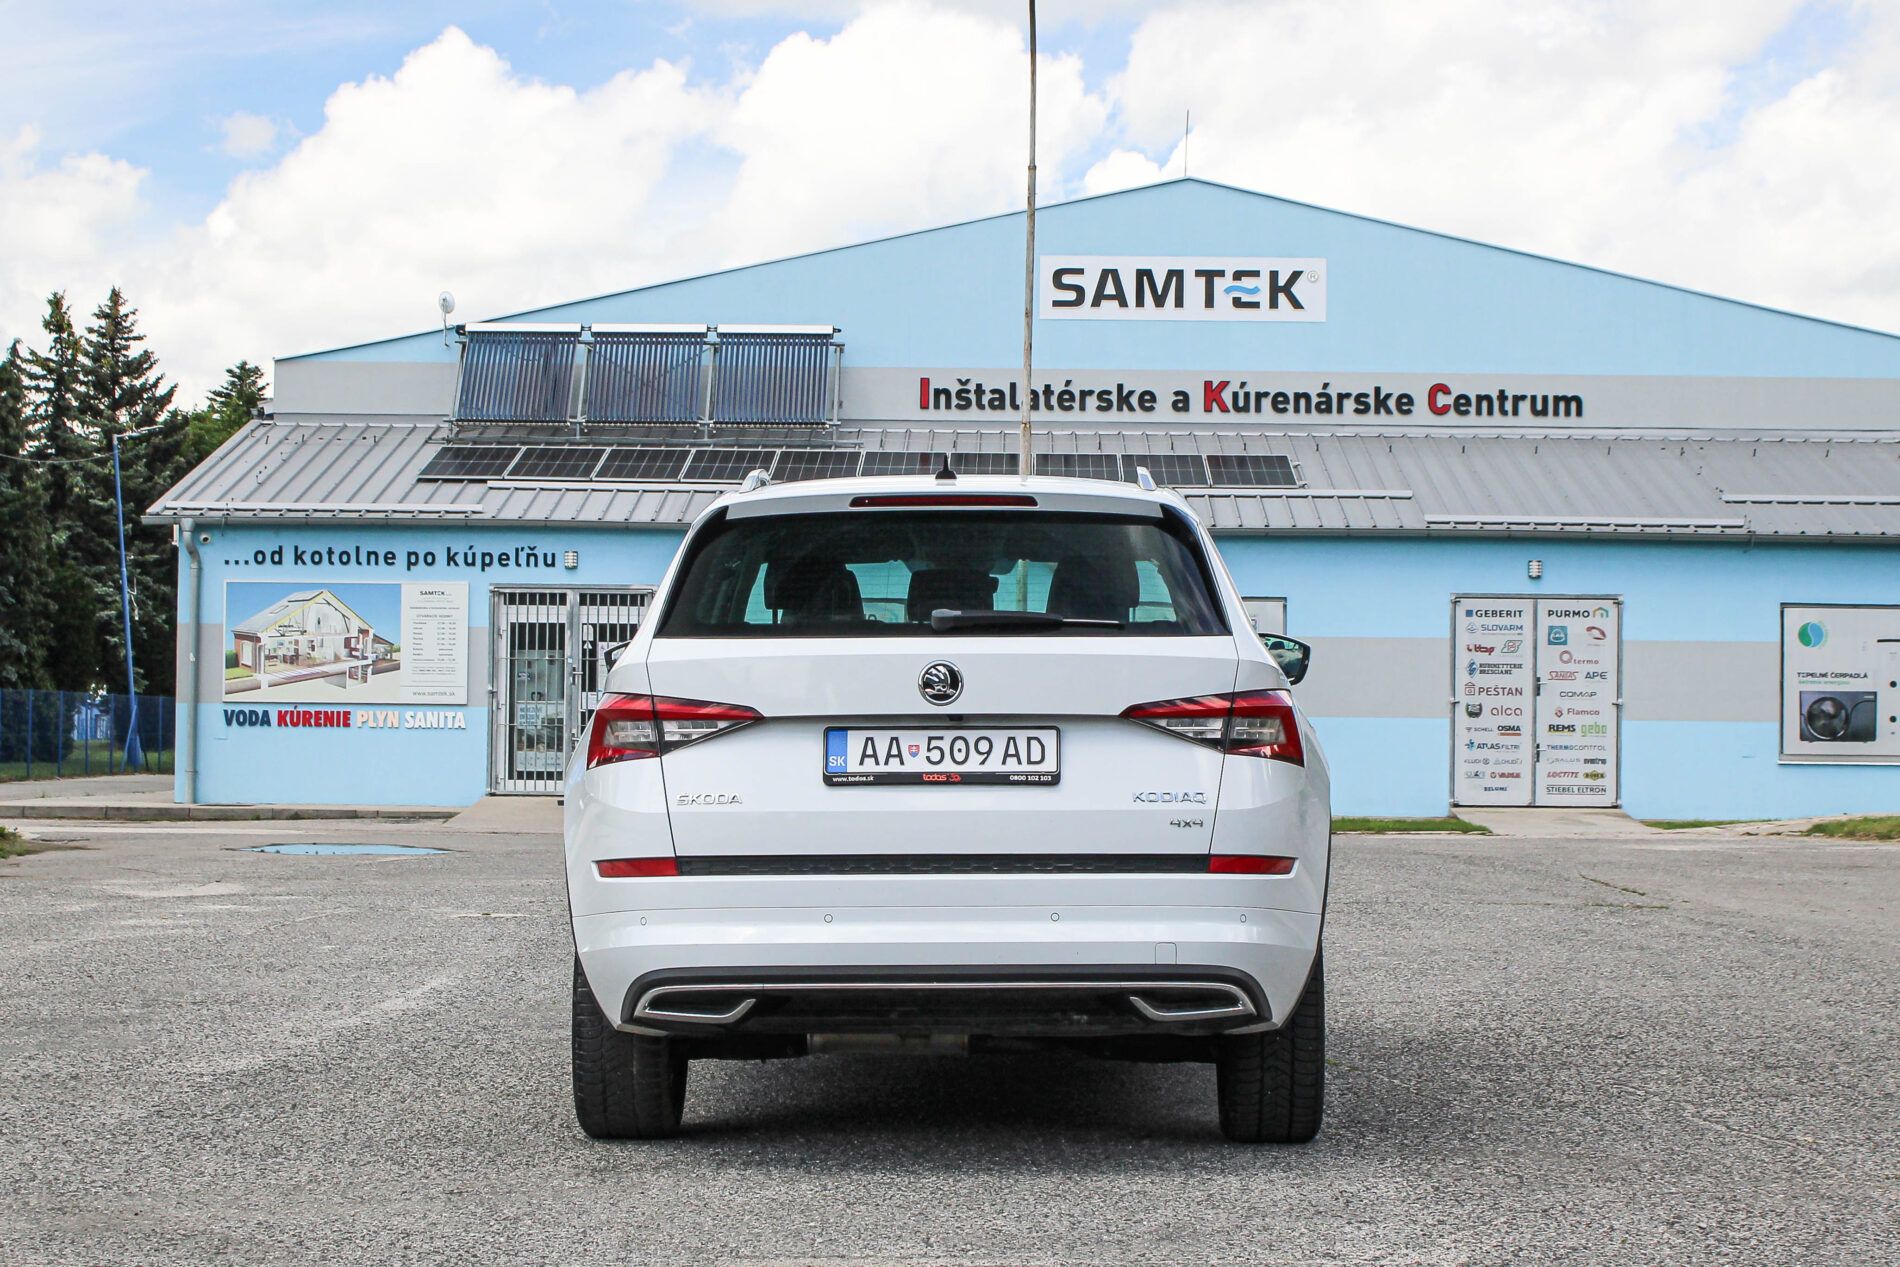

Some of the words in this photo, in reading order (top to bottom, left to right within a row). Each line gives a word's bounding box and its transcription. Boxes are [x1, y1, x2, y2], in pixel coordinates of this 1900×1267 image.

[1052, 267, 1305, 310] SAMTEK
[920, 377, 1157, 412] Inštalatérske
[1171, 383, 1190, 412] a
[1203, 380, 1414, 415] Kúrenárske
[1428, 383, 1583, 417] Centrum
[294, 545, 397, 567] kotolne
[407, 550, 437, 571] po
[446, 546, 557, 572] kúpeľňu
[1475, 609, 1524, 618] GEBERIT
[1547, 609, 1590, 618] PURMO
[1480, 624, 1524, 632] SLOVARM
[1585, 671, 1608, 680] APE
[1478, 684, 1523, 697] PEŠTAN
[1560, 690, 1597, 698] COMAP
[1490, 705, 1523, 717] alca
[1567, 708, 1600, 716] Flamco
[223, 709, 271, 728] VODA
[277, 705, 351, 728] KÚRENIE
[356, 710, 399, 729] PLYN
[404, 711, 466, 730] SANITA
[1548, 724, 1576, 733] REMS
[1581, 721, 1607, 737] gebo
[829, 755, 846, 767] SK
[922, 773, 947, 782] todos
[1009, 774, 1026, 782] 0800
[1132, 791, 1206, 805] KODIAQ
